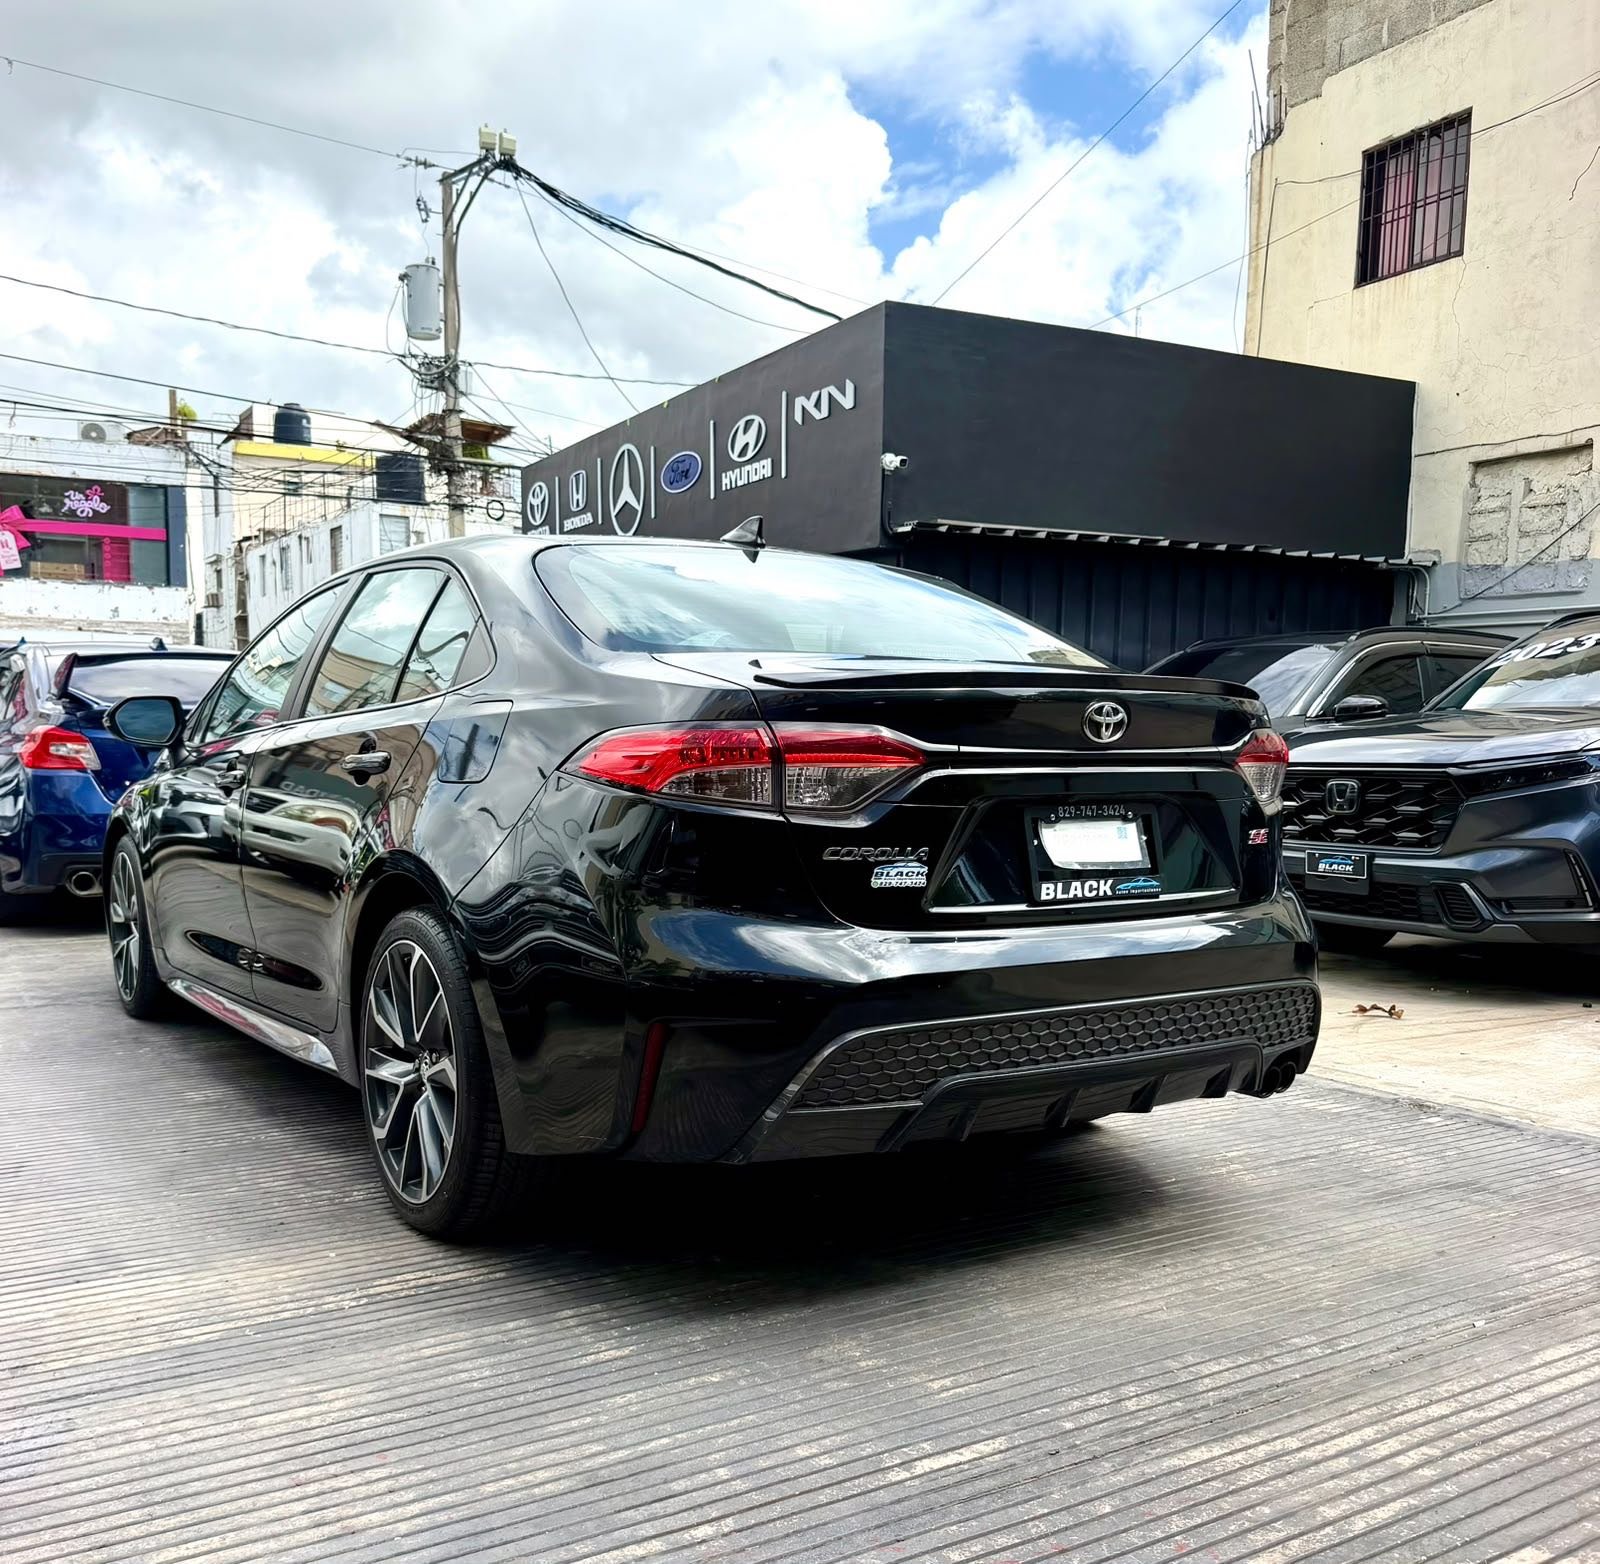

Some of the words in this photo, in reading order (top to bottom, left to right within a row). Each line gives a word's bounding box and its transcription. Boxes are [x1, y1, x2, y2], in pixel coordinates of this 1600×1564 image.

[721, 458, 772, 491] HYUNDAI
[563, 512, 594, 532] HONDA
[1058, 804, 1126, 818] 829-747-3424
[1248, 828, 1269, 845] SE
[822, 846, 929, 862] COROLLA
[874, 870, 928, 878] BLACK
[1318, 863, 1354, 872] BLACK
[1040, 880, 1114, 900] BLACK
